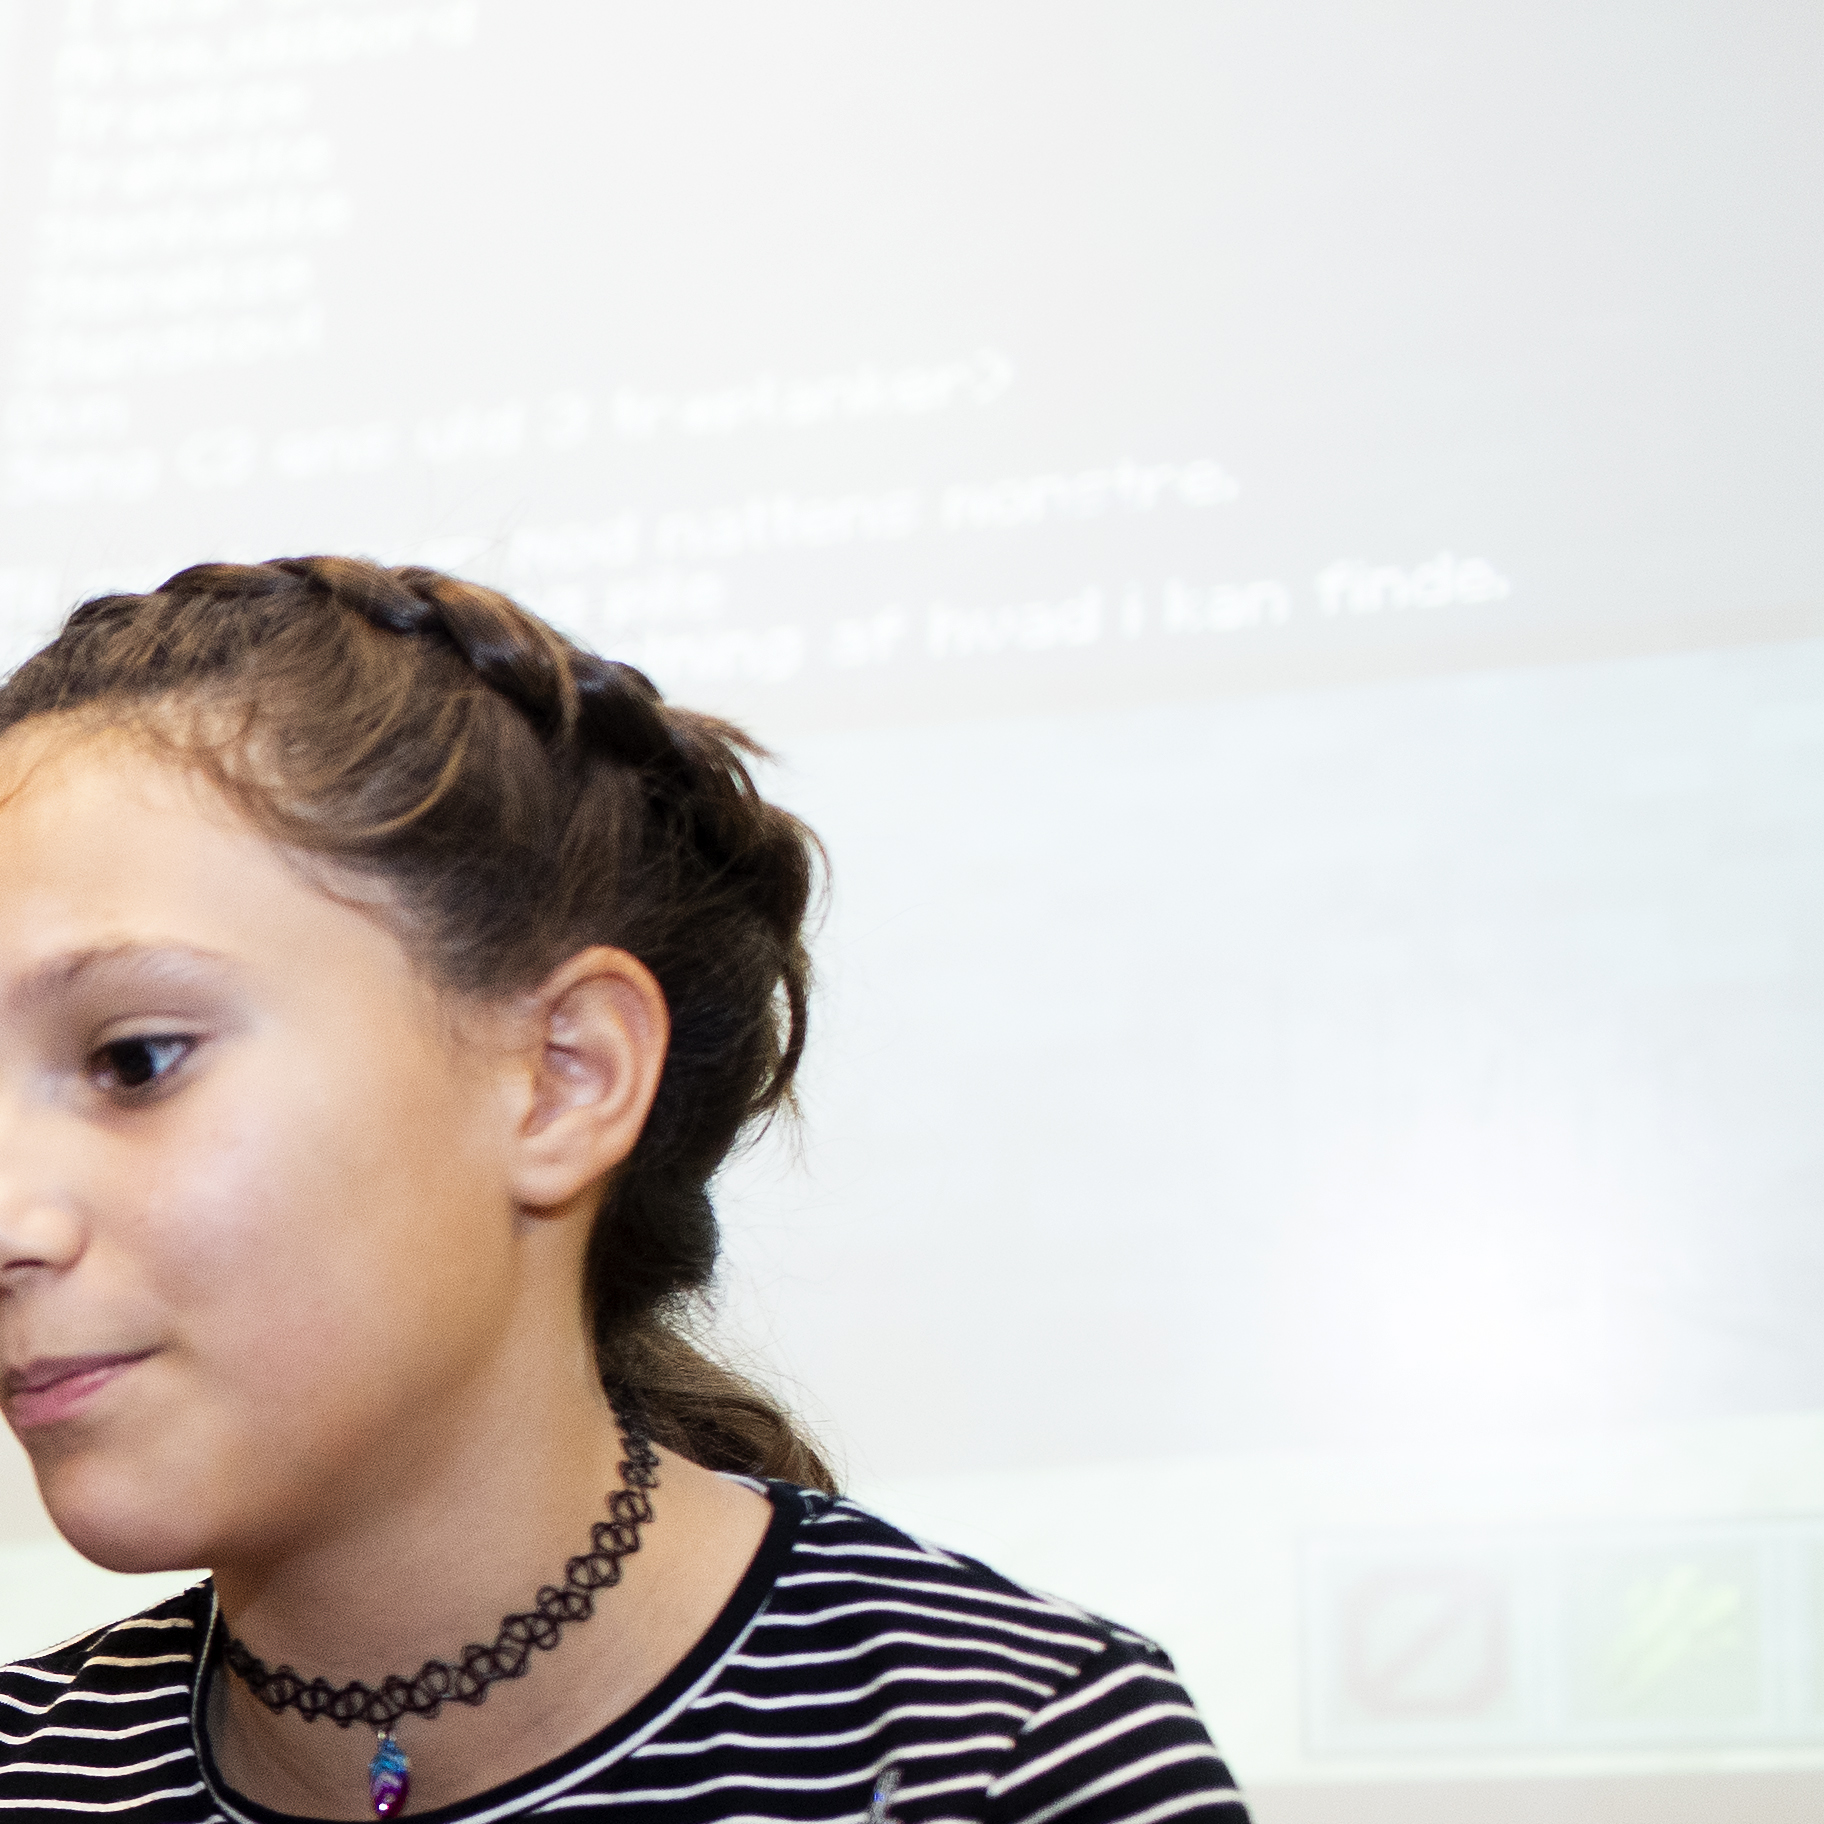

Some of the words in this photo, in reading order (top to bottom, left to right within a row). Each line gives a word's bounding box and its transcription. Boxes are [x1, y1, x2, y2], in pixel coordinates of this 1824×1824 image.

[656, 488, 922, 560] nattens
[830, 602, 909, 670] af
[926, 584, 1104, 661] hvad
[1119, 579, 1146, 642] i
[1163, 576, 1292, 635] kan
[1315, 548, 1513, 617] finde.
